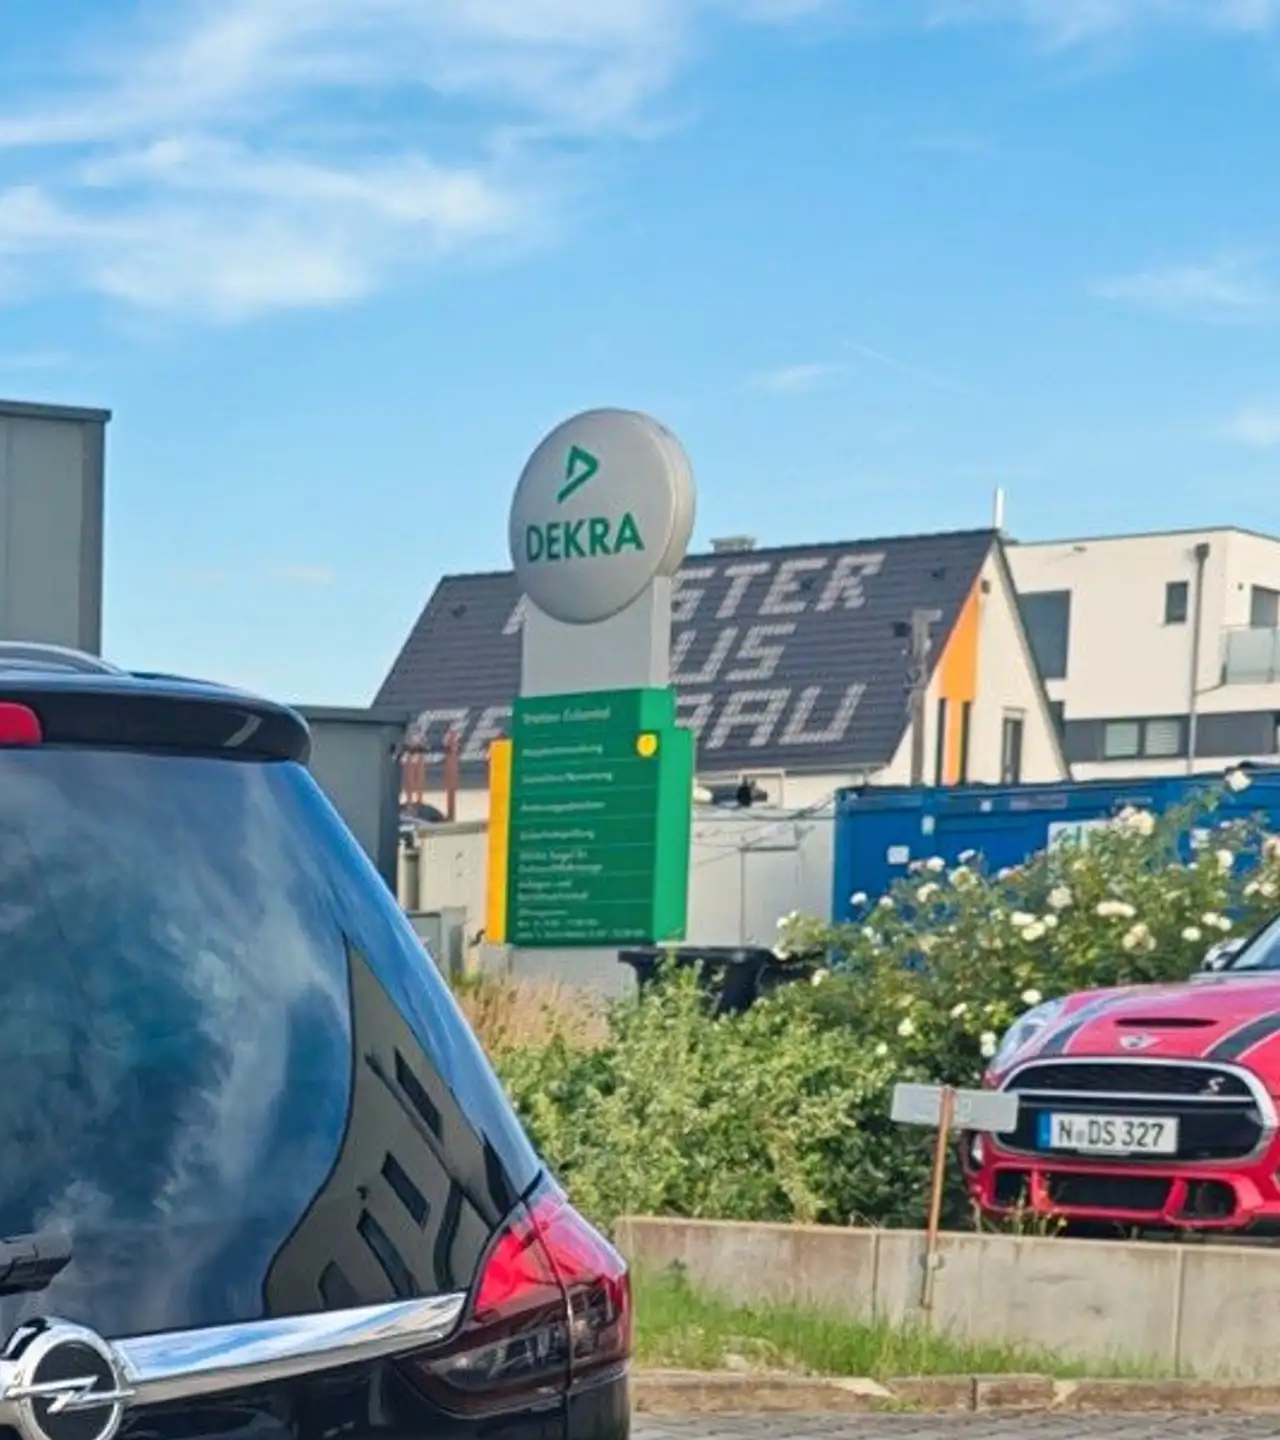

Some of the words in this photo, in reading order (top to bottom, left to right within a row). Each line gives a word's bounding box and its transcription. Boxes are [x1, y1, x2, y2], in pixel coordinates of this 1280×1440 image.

[525, 511, 645, 563] DEKRA
[670, 622, 798, 684] US
[1121, 1122, 1165, 1148] 327
